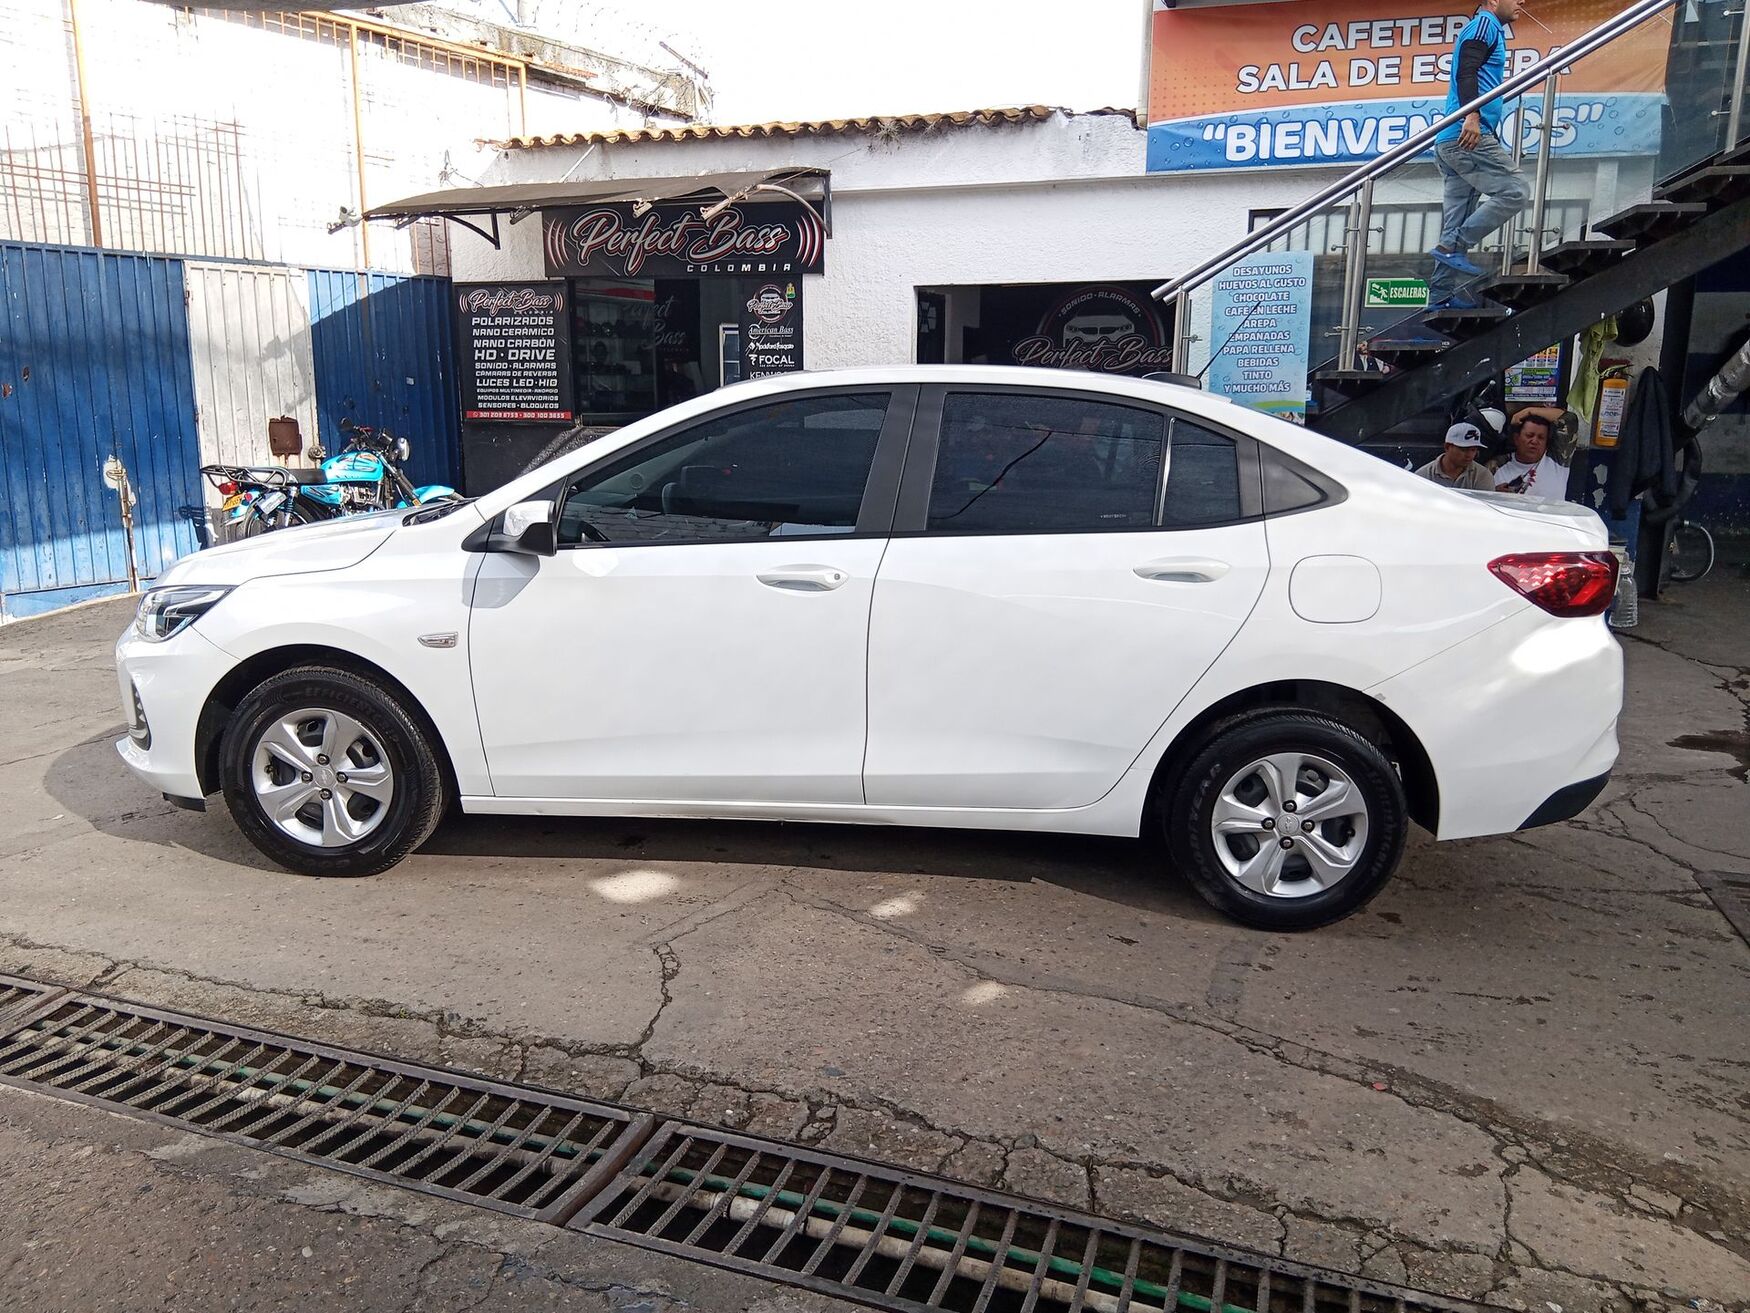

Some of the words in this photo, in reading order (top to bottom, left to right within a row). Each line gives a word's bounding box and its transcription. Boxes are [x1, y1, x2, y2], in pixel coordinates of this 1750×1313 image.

[1291, 14, 1515, 53] CAFETER
[1236, 60, 1339, 94] SALA
[1349, 56, 1402, 87] DE
[571, 209, 690, 276] Perfect
[687, 207, 791, 265] Bass
[686, 263, 792, 273] COLOMBIA
[1233, 265, 1292, 276] DESAYUNOS
[1219, 280, 1257, 290] HUEVOS
[1258, 279, 1272, 288] AL
[1274, 277, 1306, 288] GUSTO
[1233, 291, 1290, 303] CHOCOLATE
[1389, 287, 1427, 299] ESCALERAS
[468, 289, 513, 316] Perfect
[512, 288, 554, 312] Bass
[1061, 293, 1093, 315] SONIDO
[1098, 291, 1141, 314] ALARMAS
[1251, 305, 1264, 315] EN
[1266, 304, 1297, 314] LECHE
[471, 316, 554, 326] POLARIZADOS
[1243, 319, 1277, 328] AREPA
[472, 328, 500, 336] NANO
[501, 326, 554, 336] CERÁMICO
[748, 326, 778, 335] American
[779, 325, 794, 334] Bass
[1229, 331, 1291, 342] EMPANADAS
[473, 339, 505, 348] NANO
[507, 337, 555, 348] CARBÓN
[474, 349, 497, 360] HD
[508, 349, 556, 360] DRIVE
[1013, 336, 1101, 369] Perfect
[1101, 333, 1172, 372] Bass
[1222, 345, 1249, 355] PAPA
[1251, 344, 1295, 355] RELLENA
[759, 355, 795, 364] FOCAL
[1237, 357, 1280, 368] BEBIDAS
[1243, 370, 1272, 380] TINTO
[476, 378, 510, 386] LUCES
[512, 378, 534, 386] LED
[538, 378, 558, 387] HID
[1224, 384, 1231, 393] Y
[1232, 383, 1266, 393] MUCHO
[1268, 380, 1291, 392] MÁS
